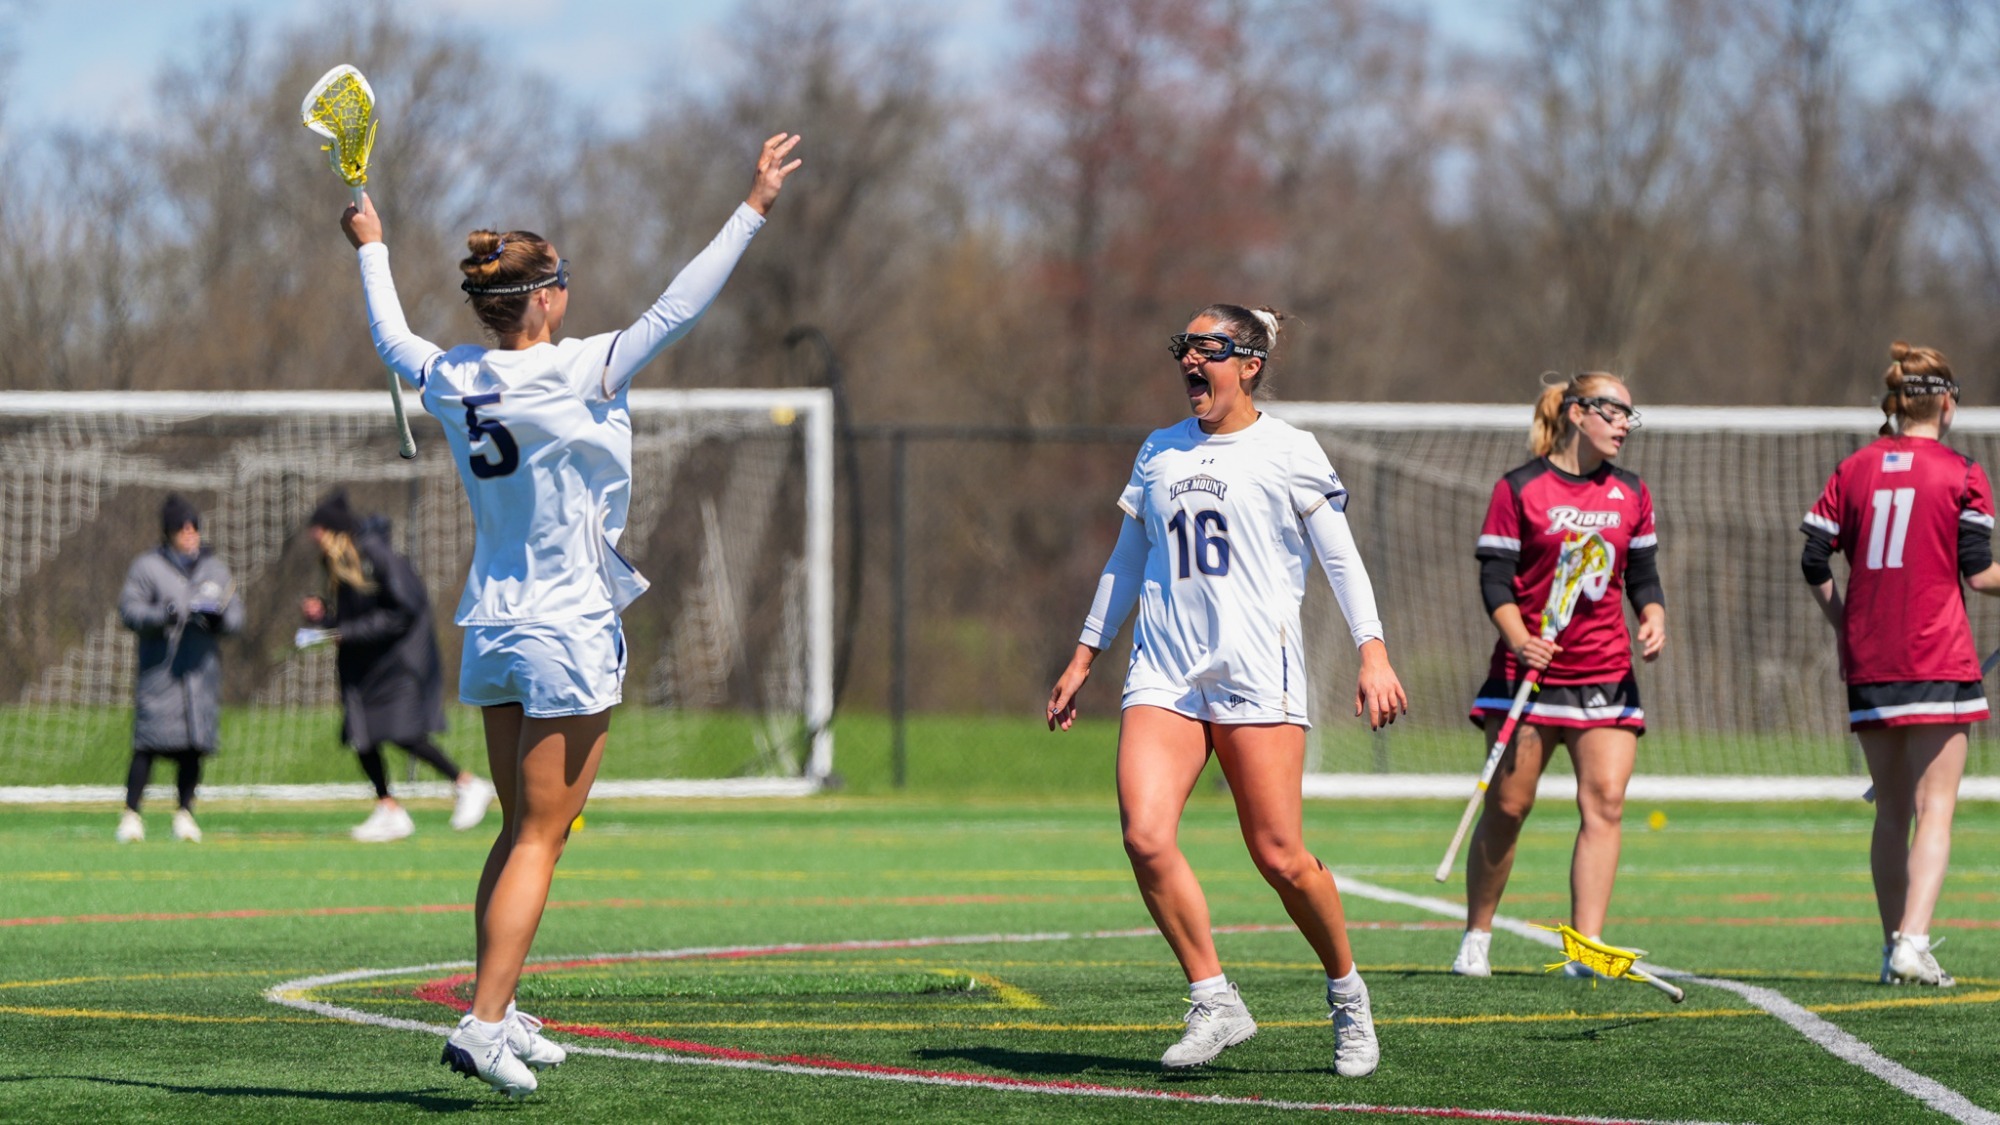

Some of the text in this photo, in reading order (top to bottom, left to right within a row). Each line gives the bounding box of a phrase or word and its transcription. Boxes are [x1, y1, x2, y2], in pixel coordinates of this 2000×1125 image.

[1234, 346, 1252, 355] GAIT
[462, 392, 519, 479] 5
[1169, 477, 1228, 501] THE MOUNT
[1168, 508, 1230, 579] 16
[1866, 487, 1916, 570] 11
